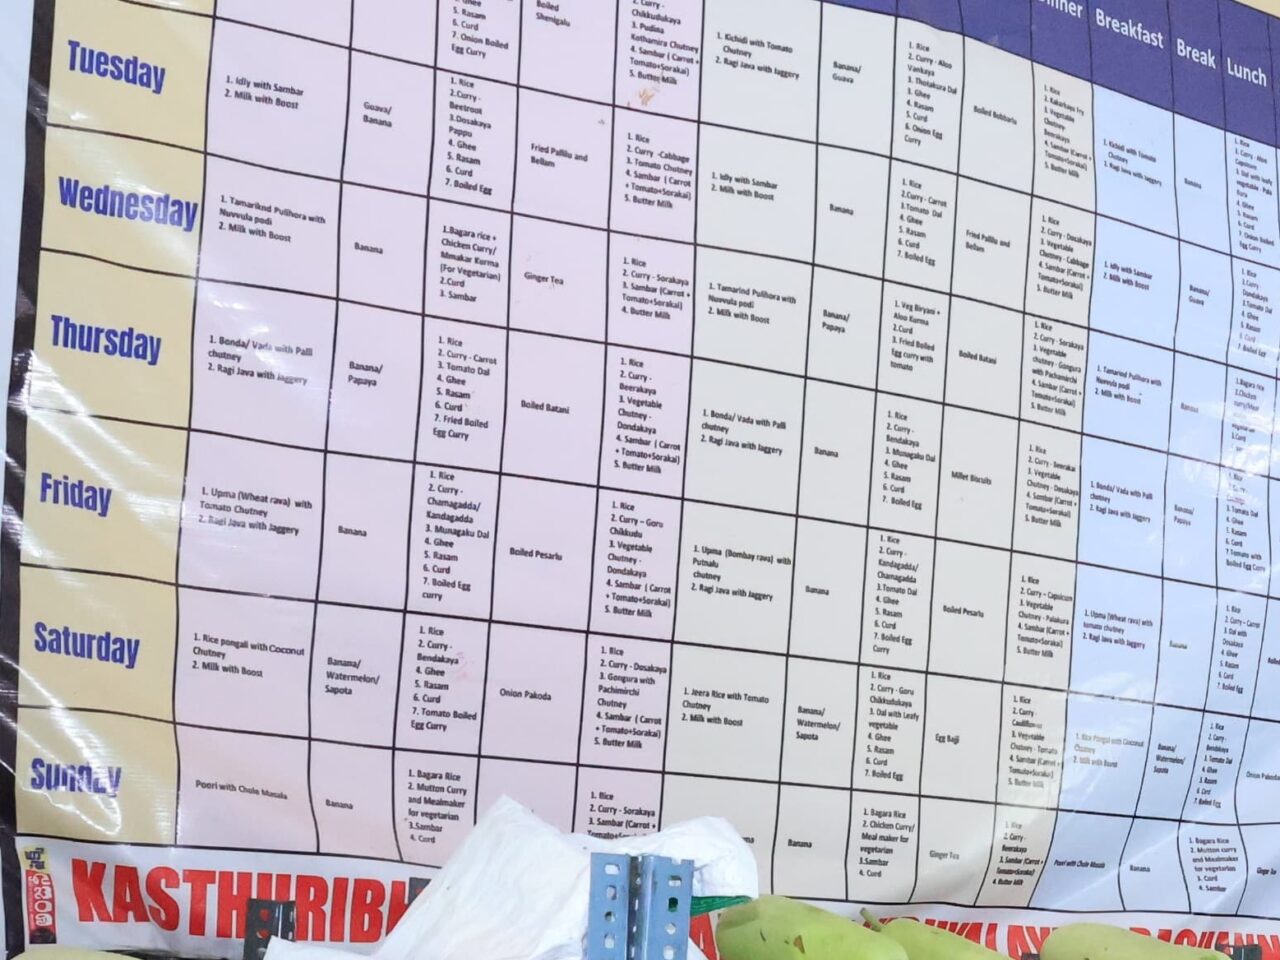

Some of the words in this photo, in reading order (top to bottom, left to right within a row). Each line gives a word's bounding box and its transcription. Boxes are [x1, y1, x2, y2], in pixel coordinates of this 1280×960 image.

[1095, 8, 1163, 48] Breakfast
[1177, 38, 1215, 68] Break
[1227, 57, 1266, 86] Lunch
[68, 40, 165, 93] Tuesday
[235, 76, 251, 89] Idly
[253, 81, 272, 91] with
[273, 83, 304, 97] Sambar
[234, 90, 253, 102] Milk
[254, 94, 274, 105] with
[275, 97, 299, 110] Boost
[449, 100, 483, 116] Beetroot
[362, 114, 393, 128] Banana
[448, 125, 473, 138] Pappu
[530, 142, 550, 154] Fried
[574, 153, 589, 162] and
[530, 155, 556, 168] Bellam
[453, 179, 478, 192] Boiled
[479, 184, 493, 196] Egg
[58, 176, 198, 233] Wednesday
[254, 216, 273, 226] podi
[307, 215, 326, 224] with
[354, 241, 384, 255] Banana
[440, 237, 471, 251] Chicken
[471, 243, 497, 256] Curry/
[523, 271, 549, 284] Ginger
[550, 275, 564, 286] Tea
[51, 314, 161, 366] Thursday
[348, 360, 384, 375] Banana/
[347, 374, 378, 388] Papaya
[520, 399, 545, 411] Boiled
[616, 420, 657, 436] Dondakaya
[40, 472, 112, 517] Friday
[337, 525, 368, 537] Banana
[609, 526, 643, 539] Chikkudu
[509, 546, 534, 558] Boiled
[34, 622, 140, 669] Saturday
[202, 633, 219, 645] Rice
[249, 642, 269, 652] with
[268, 644, 305, 656] Coconut
[192, 646, 227, 661] Chutney
[416, 652, 459, 666] Bendakaya
[201, 661, 220, 672] Milk
[221, 664, 240, 674] with
[241, 666, 264, 678] Boost
[327, 656, 362, 670] Banana/
[326, 670, 381, 686] Watermelon/
[324, 684, 353, 696] Sapota
[499, 687, 523, 698] Onion
[524, 690, 552, 701] Pakoda
[596, 697, 628, 710] Chutney
[410, 719, 425, 731] Egg
[425, 721, 448, 733] Curry
[416, 769, 444, 781] Bagara
[444, 771, 462, 782] Rice
[195, 779, 218, 790] Poori
[218, 783, 237, 792] with
[416, 782, 445, 793] Mutton
[446, 785, 468, 797] Curry
[325, 798, 354, 810] Banana
[407, 795, 422, 805] and
[408, 807, 420, 817] for
[420, 811, 460, 821] vegetarian
